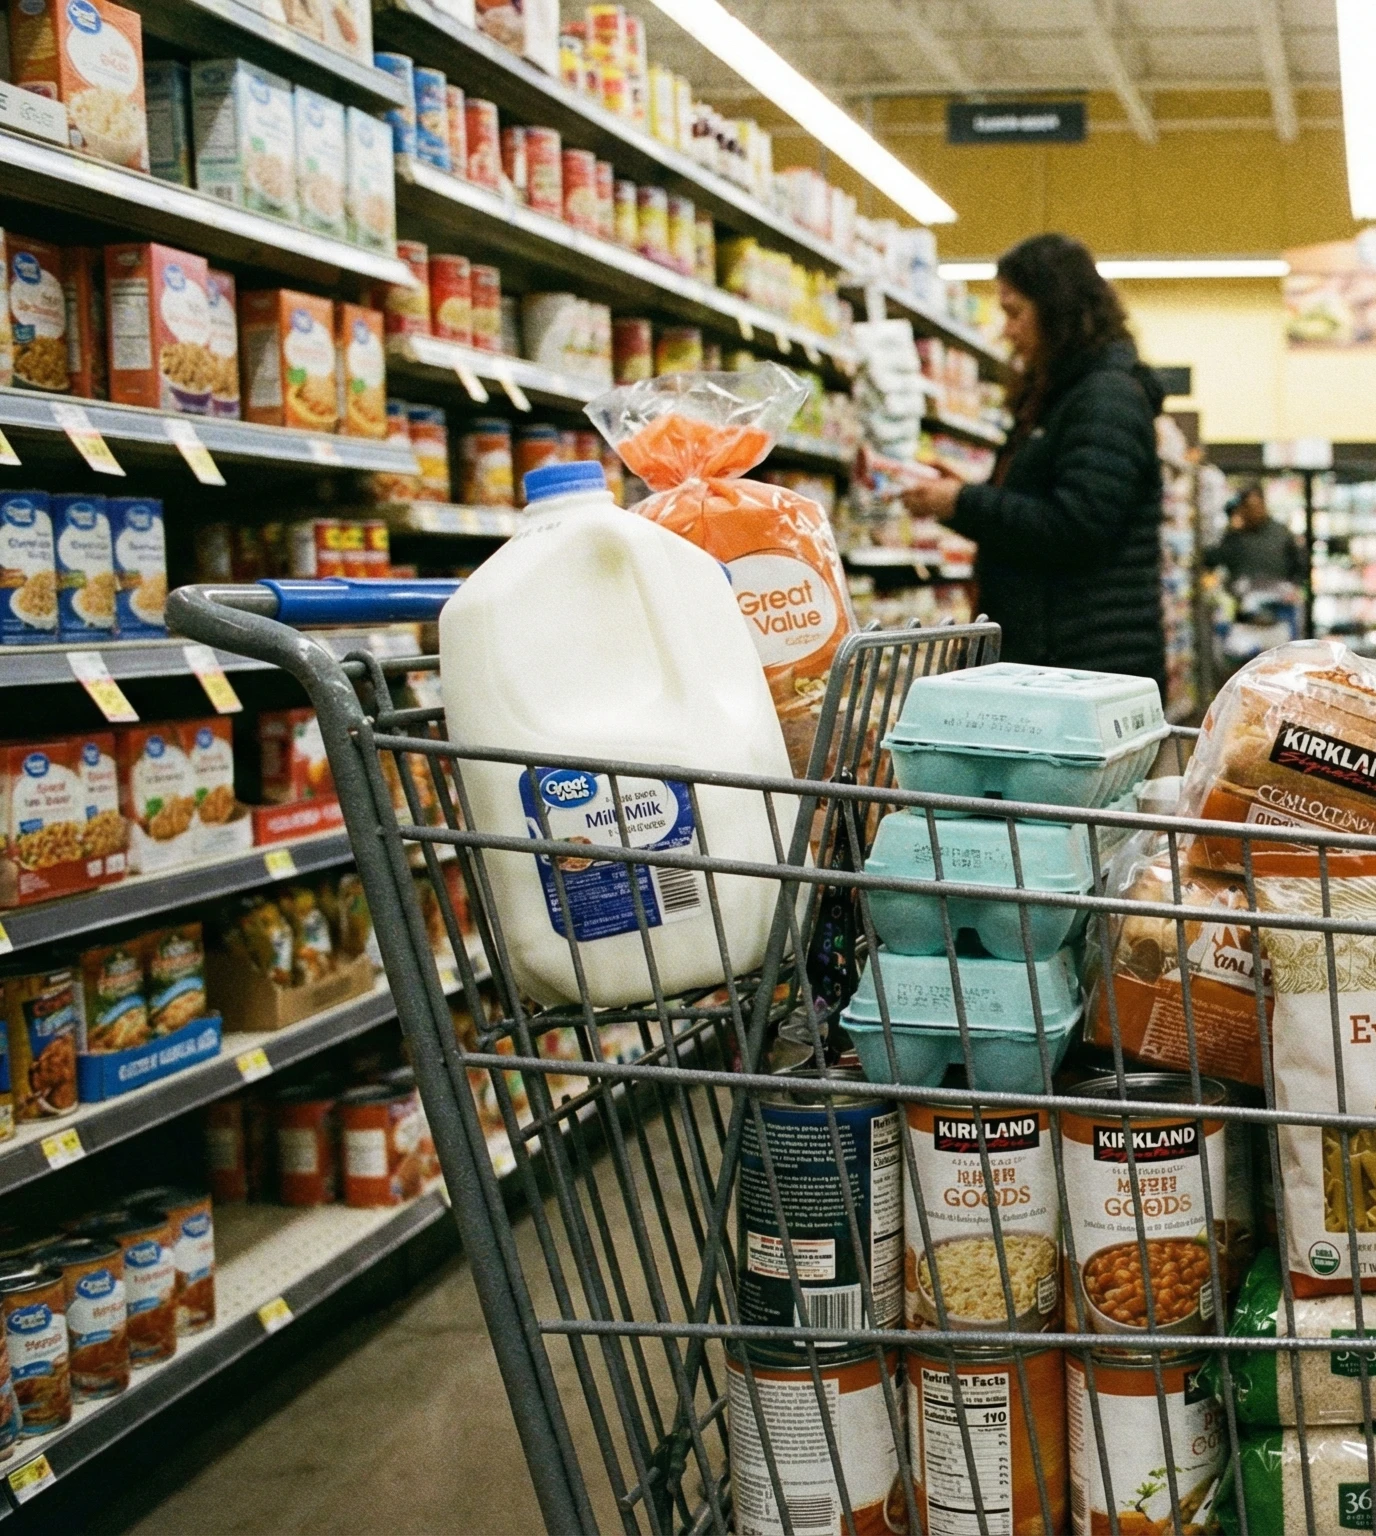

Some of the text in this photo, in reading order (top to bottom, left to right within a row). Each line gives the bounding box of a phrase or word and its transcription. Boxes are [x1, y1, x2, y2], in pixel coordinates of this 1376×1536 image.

[737, 580, 813, 615] Great
[753, 610, 821, 635] Value
[585, 802, 663, 828] Mil Milk
[944, 1185, 1031, 1208] GOODS
[1104, 1194, 1192, 1217] GOODS
